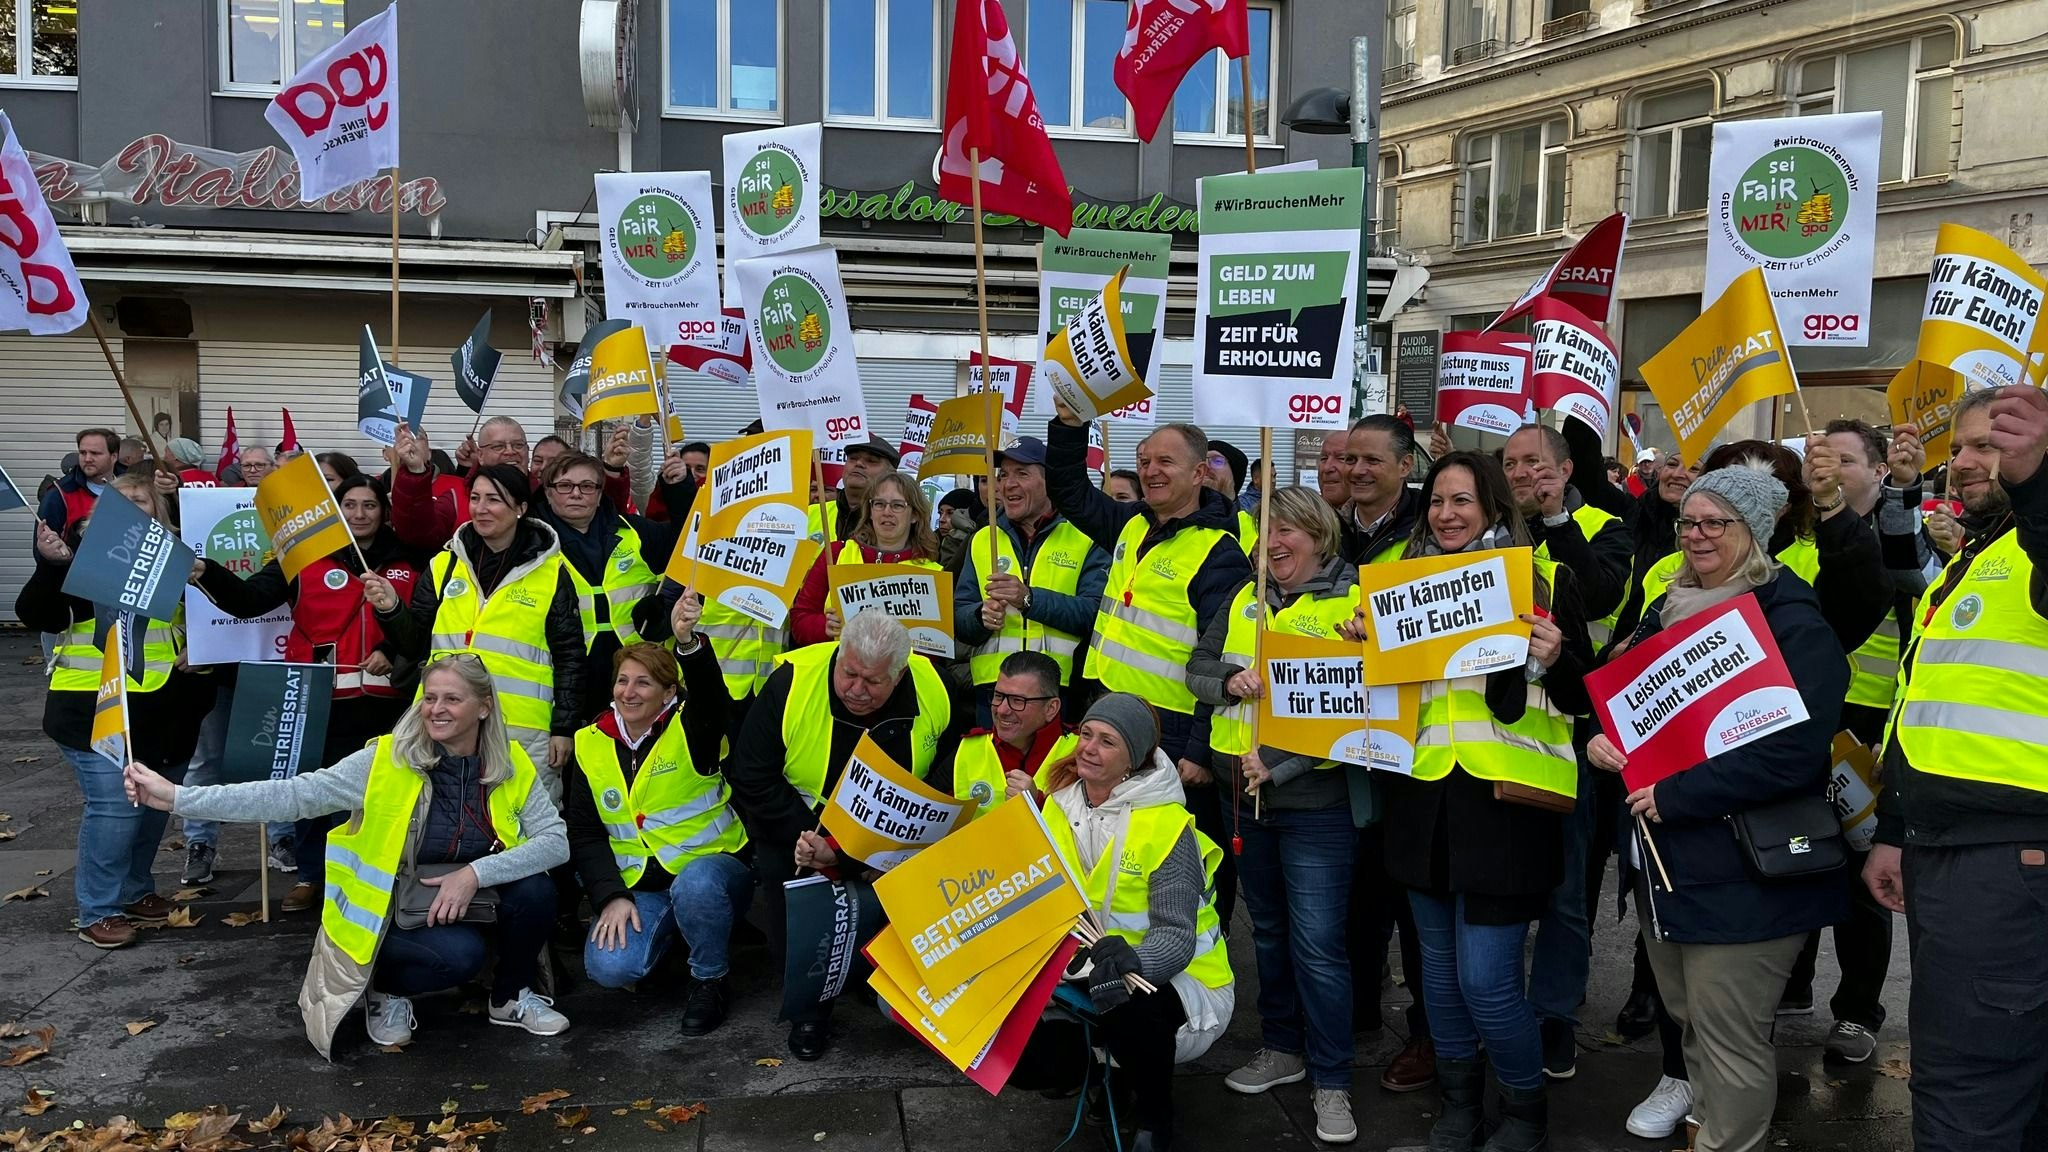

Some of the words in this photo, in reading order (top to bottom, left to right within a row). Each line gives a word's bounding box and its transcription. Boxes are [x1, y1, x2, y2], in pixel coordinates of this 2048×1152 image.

[756, 156, 771, 172] sei
[1768, 156, 1796, 174] sei
[1773, 136, 1859, 192] #wirbrauchenmehr
[638, 203, 656, 214] sei
[742, 200, 768, 218] MIR!
[821, 180, 964, 222] ssalon
[1214, 195, 1345, 212] #WirBrauchenMehr
[1720, 192, 1730, 220] GELD
[1775, 202, 1792, 211] zu
[774, 206, 792, 218] gpa
[758, 236, 770, 246] ZEIT
[770, 234, 780, 245] für
[780, 214, 806, 240] Erholung
[1722, 222, 1734, 241] zum
[1740, 214, 1790, 234] MIR!
[1801, 224, 1828, 237] gpa
[608, 226, 617, 248] GELD
[612, 250, 623, 266] zum
[625, 244, 658, 258] MIR!
[666, 252, 686, 263] gpa
[1054, 246, 1158, 262] #WirBrauchenMehr
[1732, 240, 1756, 264] Leben
[1807, 232, 1851, 267] Erholung
[621, 265, 640, 284] Leben
[674, 260, 701, 284] Erholung
[1220, 265, 1268, 282] GELD
[1272, 264, 1316, 281] ZUM
[1764, 260, 1787, 271] ZEIT
[1789, 260, 1806, 271] für
[644, 278, 661, 288] ZEIT
[662, 277, 673, 288] für
[1930, 258, 1961, 284] Wir
[1962, 261, 2038, 317] kämpfe
[773, 284, 790, 301] sei
[1218, 288, 1276, 306] LEBEN
[625, 301, 700, 309] #WirBrauchenMehr
[1930, 290, 1964, 316] für
[1964, 296, 2026, 344] Euch!
[678, 320, 716, 340] gpa
[1220, 326, 1258, 344] ZEIT
[1261, 323, 1299, 344] FÜR
[1803, 314, 1860, 340] gpa
[768, 334, 797, 352] MIR!
[804, 340, 822, 352] gpa
[1088, 305, 1122, 382] kämpfen
[1401, 335, 1427, 347] AUDIO
[753, 318, 761, 343] GELD
[766, 358, 786, 380] Leben
[788, 375, 803, 384] ZEIT
[803, 372, 814, 383] für
[813, 346, 838, 379] Erholung
[1072, 328, 1101, 380] Euch!
[1219, 350, 1322, 368] ERHOLUNG
[1400, 346, 1435, 356] DANUBE
[1555, 325, 1618, 381] kämpfen
[1440, 354, 1478, 373] Leistung
[1480, 360, 1510, 372] muss
[1534, 351, 1556, 372] für
[1560, 352, 1607, 392] Euch!
[1690, 346, 1726, 384] Dein
[1468, 376, 1514, 390] werden!
[1672, 330, 1772, 428] BETRIEBSRAT
[776, 396, 841, 411] #WirBrauchenMehr
[1288, 394, 1342, 423] gpa
[826, 415, 862, 440] gpa
[1467, 414, 1512, 430] BETRIEBSRAT
[1680, 412, 1704, 441] BILLA
[903, 426, 929, 444] Euch!
[925, 434, 987, 456] BETRIEBSRA
[819, 448, 836, 462] für
[714, 466, 732, 488] Wir
[731, 446, 782, 479] kämpfen
[719, 486, 734, 508] für
[734, 470, 769, 496] Euch!
[234, 518, 256, 530] sei
[268, 504, 294, 528] Dein
[760, 512, 778, 522] Dein
[746, 522, 796, 530] BETRIEBSRAT
[106, 522, 144, 566] Dein
[698, 544, 723, 563] für
[724, 549, 768, 576] Euch!
[1060, 558, 1078, 566] DICH
[1980, 556, 2007, 568] wir
[386, 568, 410, 580] gpa
[1162, 566, 1178, 577] DICH
[1990, 566, 2013, 577] DICH
[748, 592, 764, 606] Dein
[840, 584, 868, 604] Wir
[869, 578, 930, 598] kämpfen
[1373, 592, 1406, 618] Wir
[1408, 570, 1496, 608] kämpfen
[732, 594, 776, 618] BETRIEBSRAT
[884, 600, 922, 616] Euch!
[211, 615, 295, 626] #WirBrauchenMe
[1298, 614, 1320, 628] wir
[1396, 618, 1424, 642] für
[1427, 600, 1484, 634] Euch!
[1308, 624, 1329, 637] DICH
[1460, 652, 1516, 668] BETRIEBSRAT
[1478, 648, 1500, 658] Dein
[1271, 660, 1300, 685] Wir
[1305, 662, 1364, 692] kämpf
[1624, 658, 1687, 712] Leistung
[1683, 630, 1728, 667] muss
[1632, 684, 1684, 738] belohnt
[1682, 643, 1751, 698] werden!
[1288, 690, 1314, 714] für
[1320, 690, 1371, 714] Euch!
[270, 668, 301, 781] BETRIEBSRAT
[1719, 706, 1790, 740] BETRIEBSRAT
[1734, 708, 1762, 723] Dein
[250, 706, 278, 747] Dein
[1345, 746, 1400, 762] BETREBSRAT
[850, 759, 873, 788] Wir
[872, 780, 950, 824] kämpfen
[850, 794, 874, 823] für
[874, 810, 926, 842] Euch!
[938, 865, 996, 908] Dein
[910, 854, 1055, 955] BETRIEBSRAT
[819, 884, 848, 1002] BETRIEBSRAT
[920, 938, 962, 970] BILLA
[958, 928, 973, 942] WIR
[971, 920, 986, 935] FÜR
[984, 913, 1000, 930] DICH
